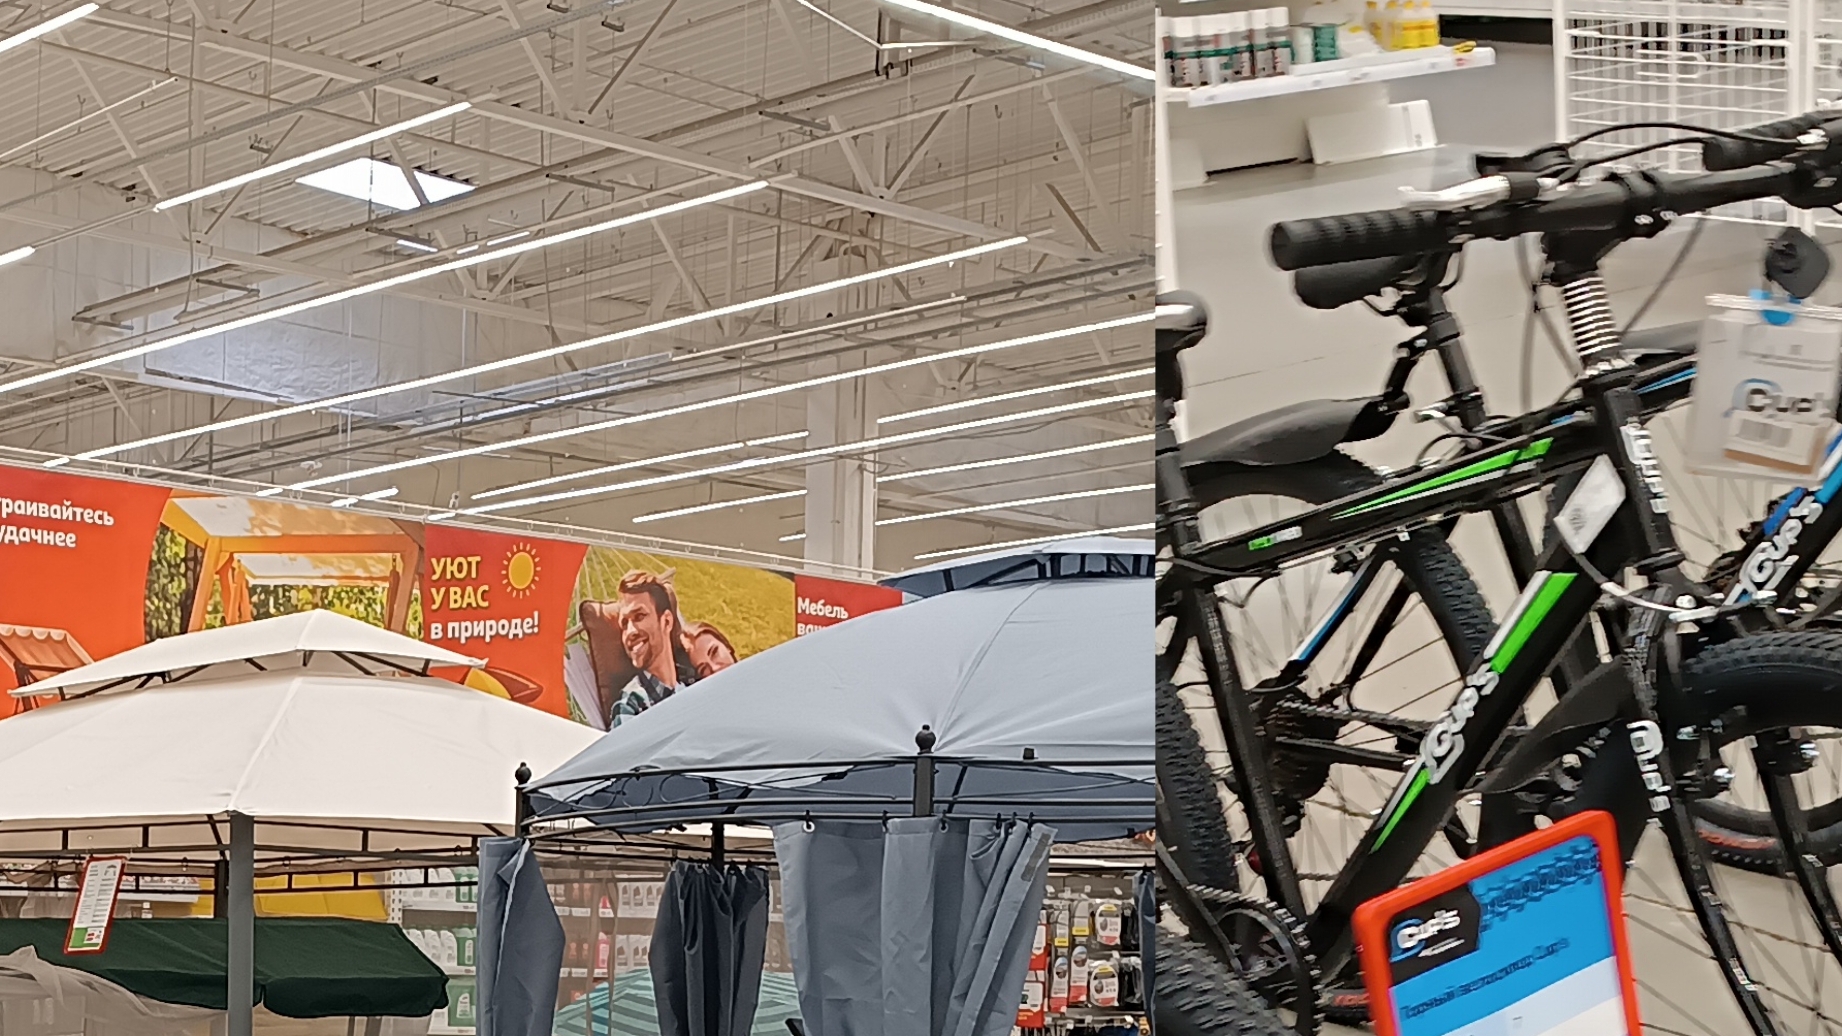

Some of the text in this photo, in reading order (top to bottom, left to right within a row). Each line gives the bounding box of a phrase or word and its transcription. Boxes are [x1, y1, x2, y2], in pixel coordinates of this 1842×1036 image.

[0, 497, 115, 526] раивайтесь
[430, 556, 482, 580] УЮТ
[430, 584, 490, 610] У ВАС
[797, 596, 849, 619] Мебель
[430, 610, 540, 645] в природе!
